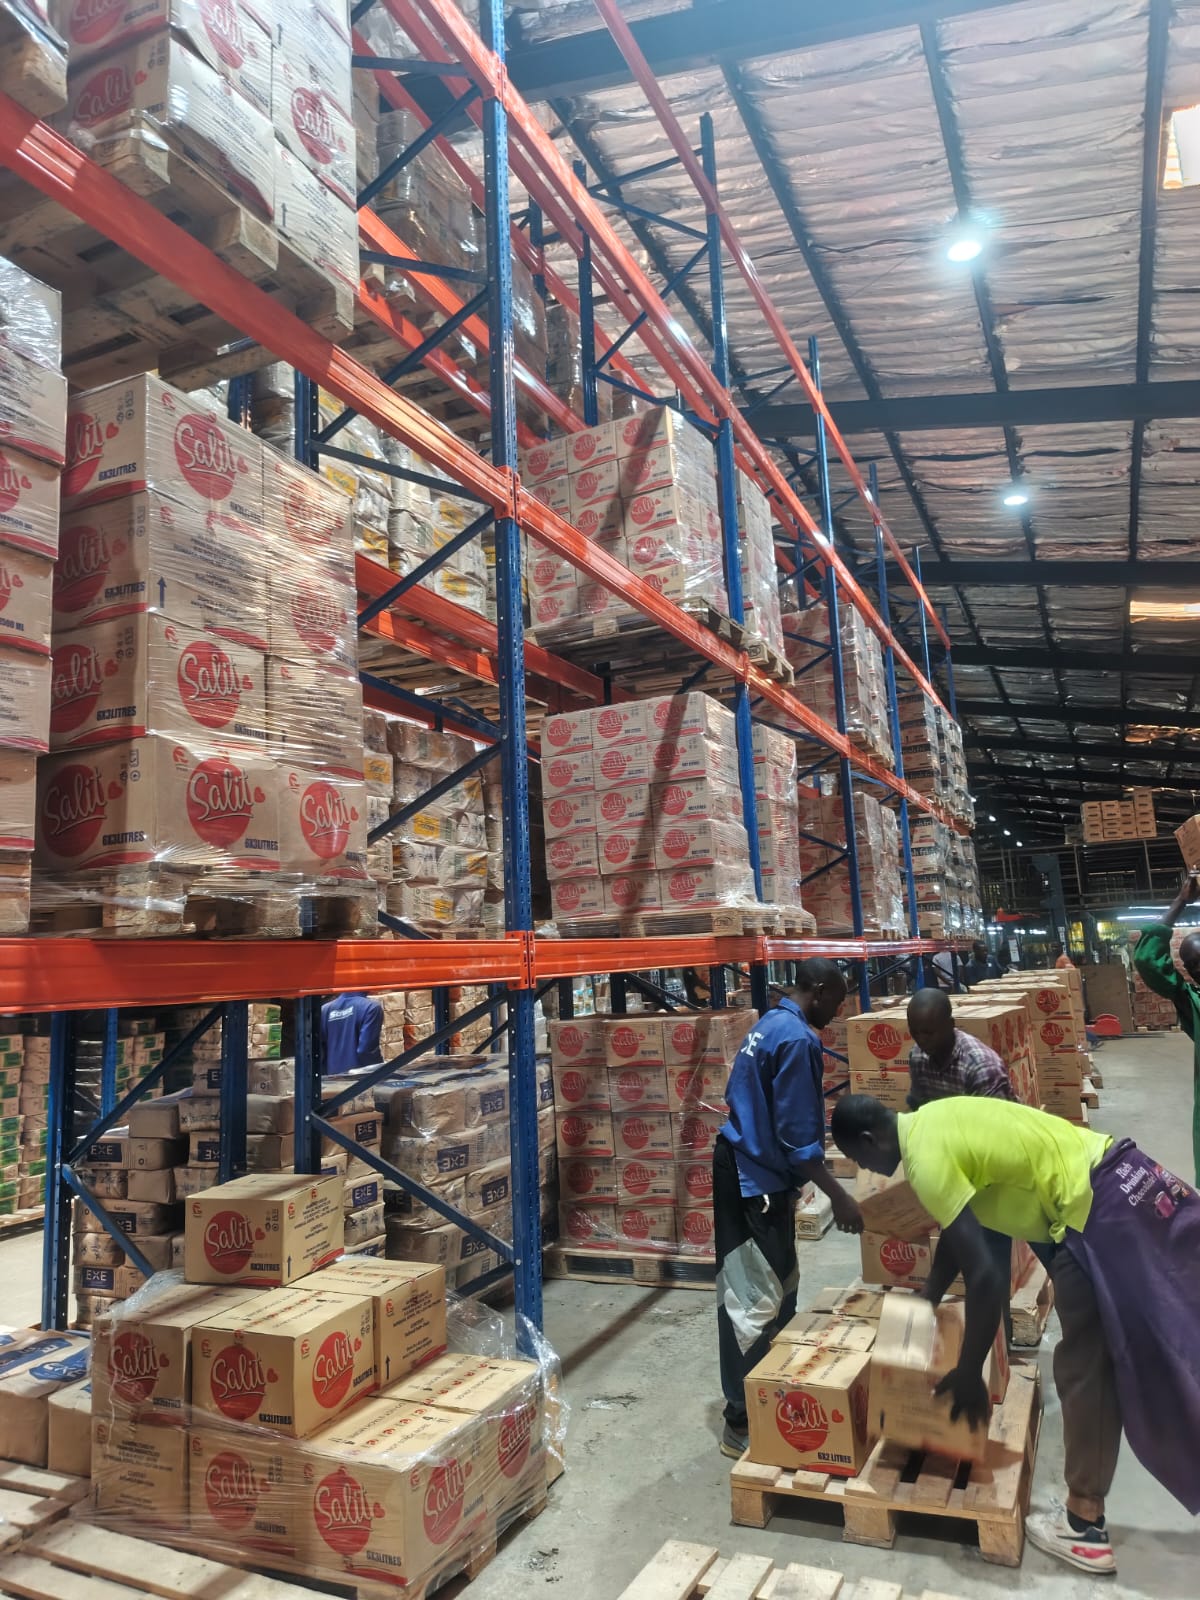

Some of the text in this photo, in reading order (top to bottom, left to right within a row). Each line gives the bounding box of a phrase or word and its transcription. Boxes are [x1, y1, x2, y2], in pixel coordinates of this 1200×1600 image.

[75, 66, 131, 120] Salit
[176, 423, 238, 473] Salit
[51, 648, 104, 700] alit
[180, 652, 243, 700] Salit
[44, 767, 106, 835] Salit
[189, 769, 254, 821] Salit
[301, 792, 351, 838] Salit
[868, 1026, 901, 1050] Salit
[91, 1144, 113, 1156] EXE
[354, 1185, 372, 1199] EXE
[205, 1216, 254, 1257] Salit
[880, 1242, 914, 1264] Salit
[86, 1269, 107, 1281] EXE
[112, 1338, 158, 1382] Salit
[211, 1353, 266, 1398] Salit
[313, 1330, 355, 1393] Salit
[778, 1401, 828, 1433] Salit
[207, 1461, 260, 1505] Salit
[425, 1464, 465, 1530] Salit
[315, 1486, 373, 1529] Salit
